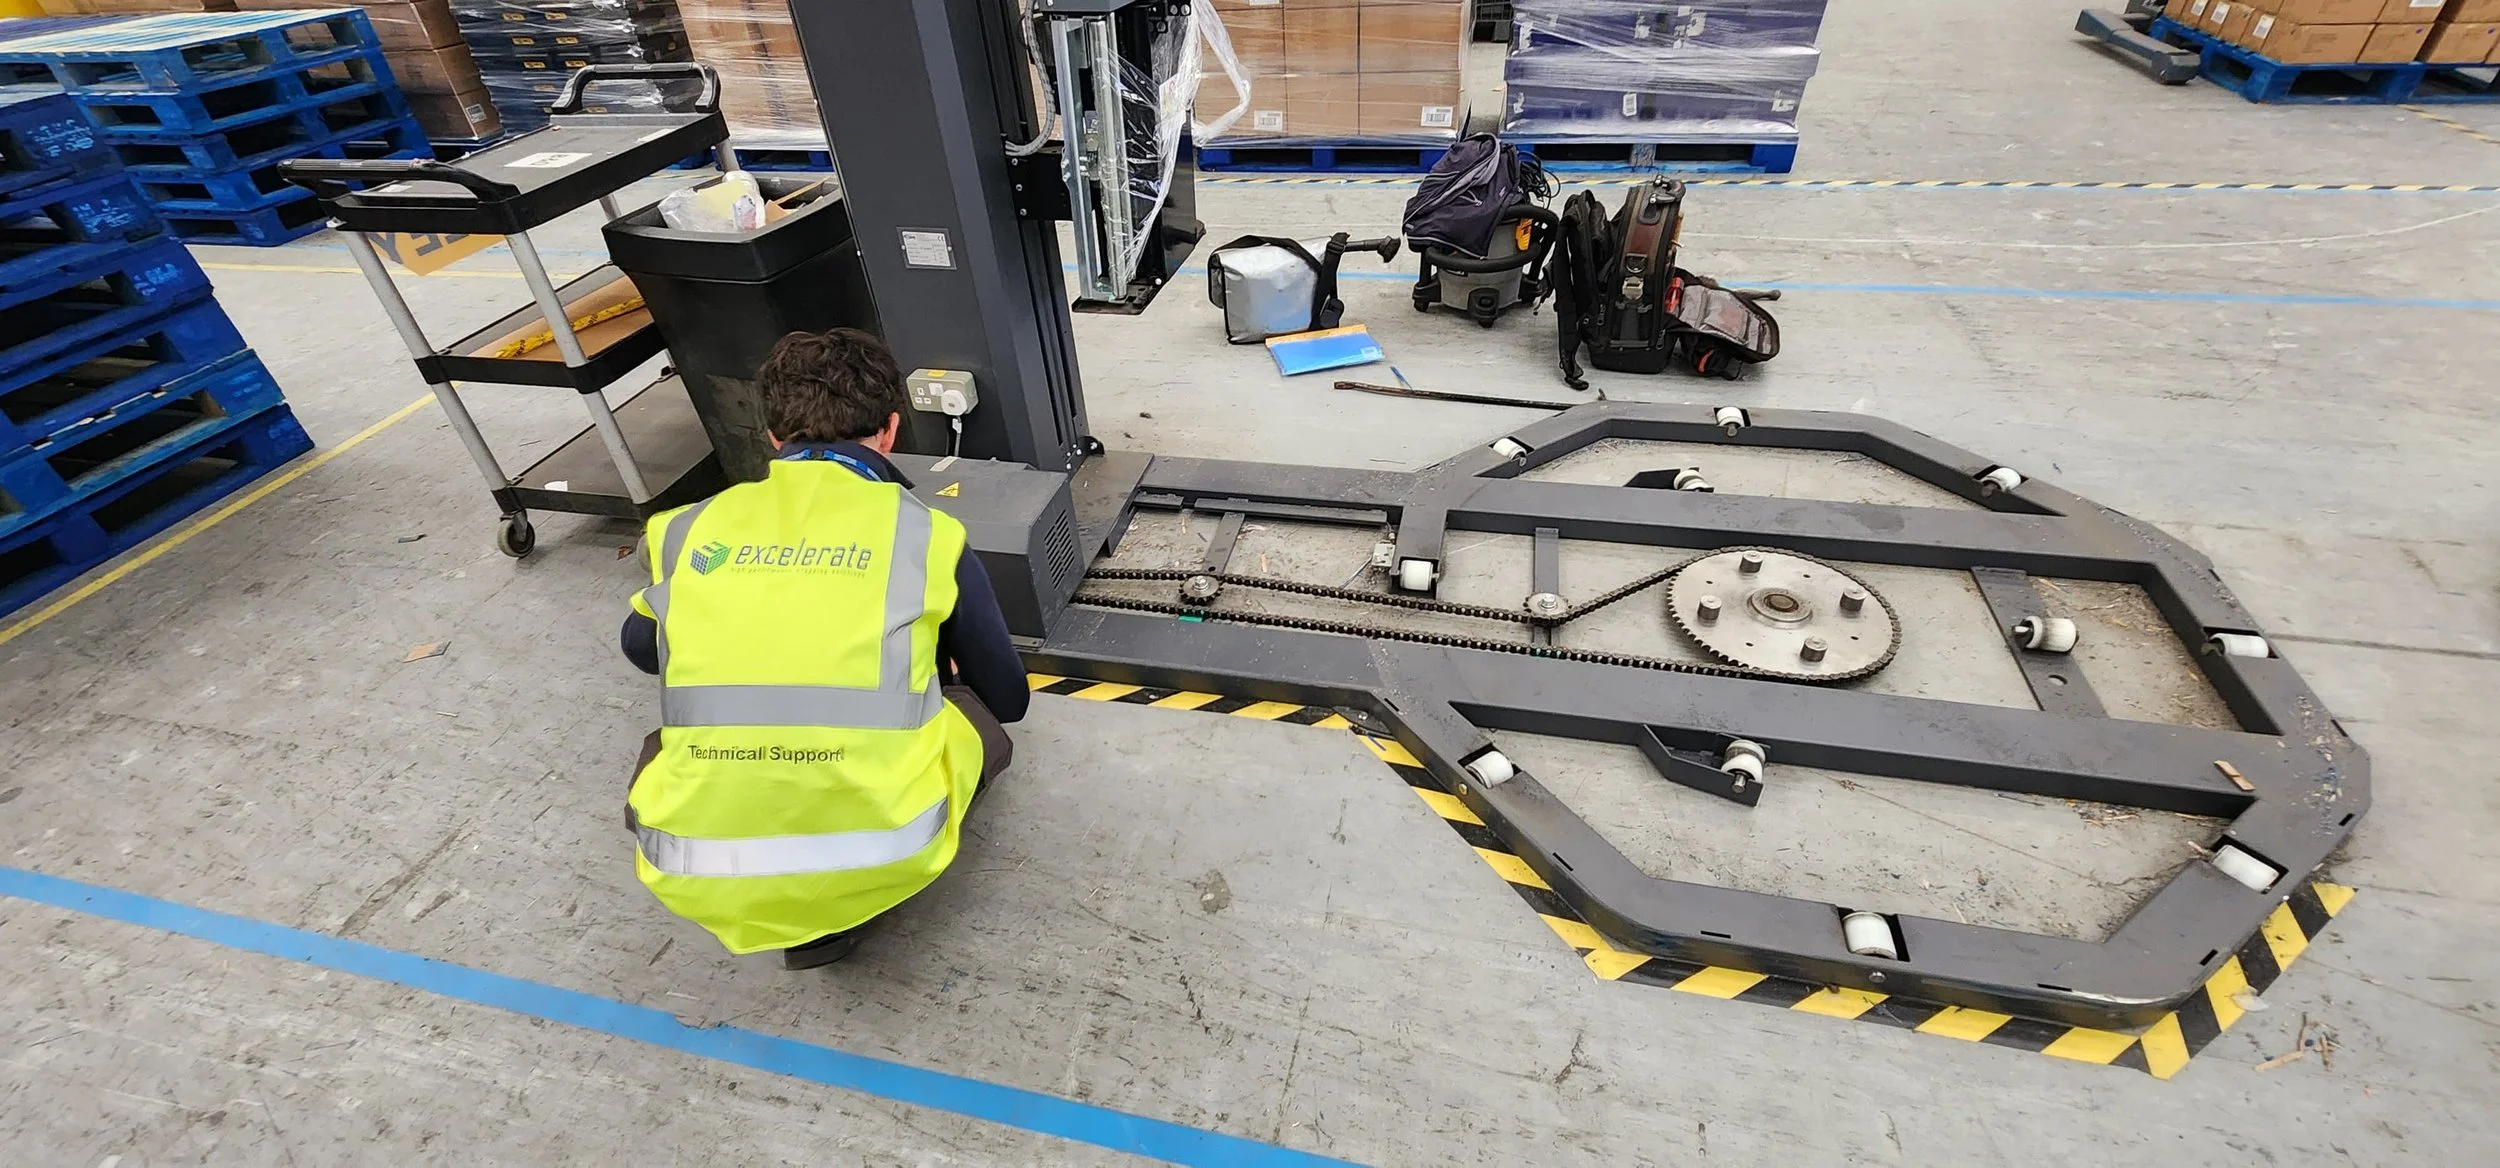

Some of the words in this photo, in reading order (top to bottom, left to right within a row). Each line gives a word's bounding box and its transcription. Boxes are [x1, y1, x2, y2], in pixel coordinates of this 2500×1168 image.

[734, 537, 872, 570] excelerate
[687, 745, 763, 760] Technical
[768, 746, 843, 764] Support
